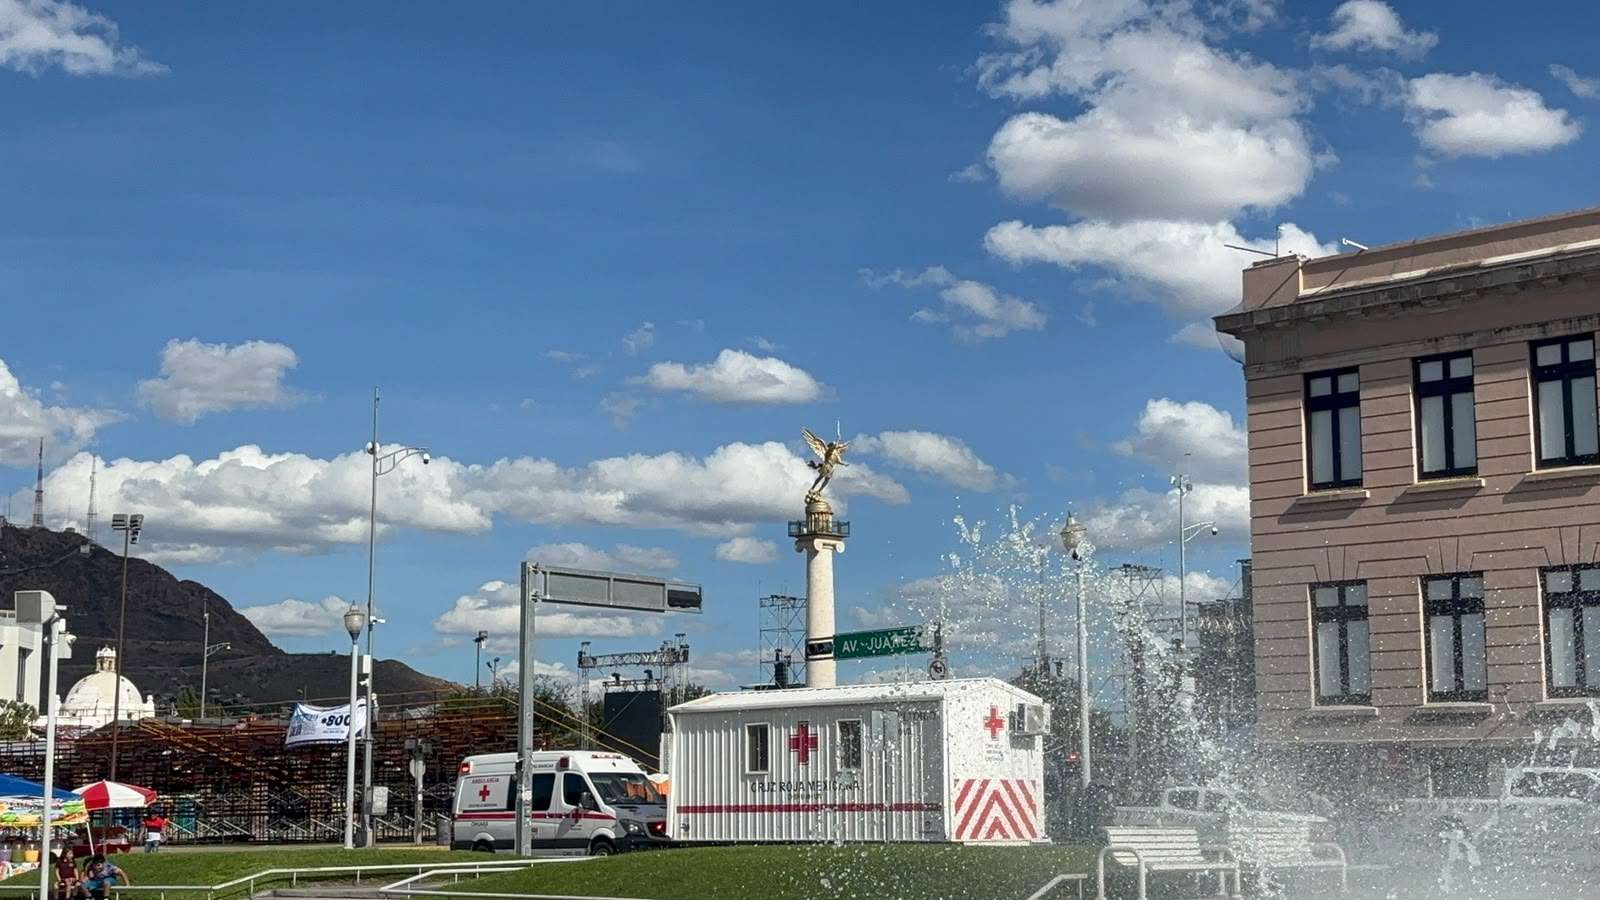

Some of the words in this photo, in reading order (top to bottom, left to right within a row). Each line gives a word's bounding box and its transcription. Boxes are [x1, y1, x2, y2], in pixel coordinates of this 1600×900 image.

[841, 640, 860, 653] AV.
[750, 782, 777, 793] CRUZ
[779, 781, 805, 793] ROJA
